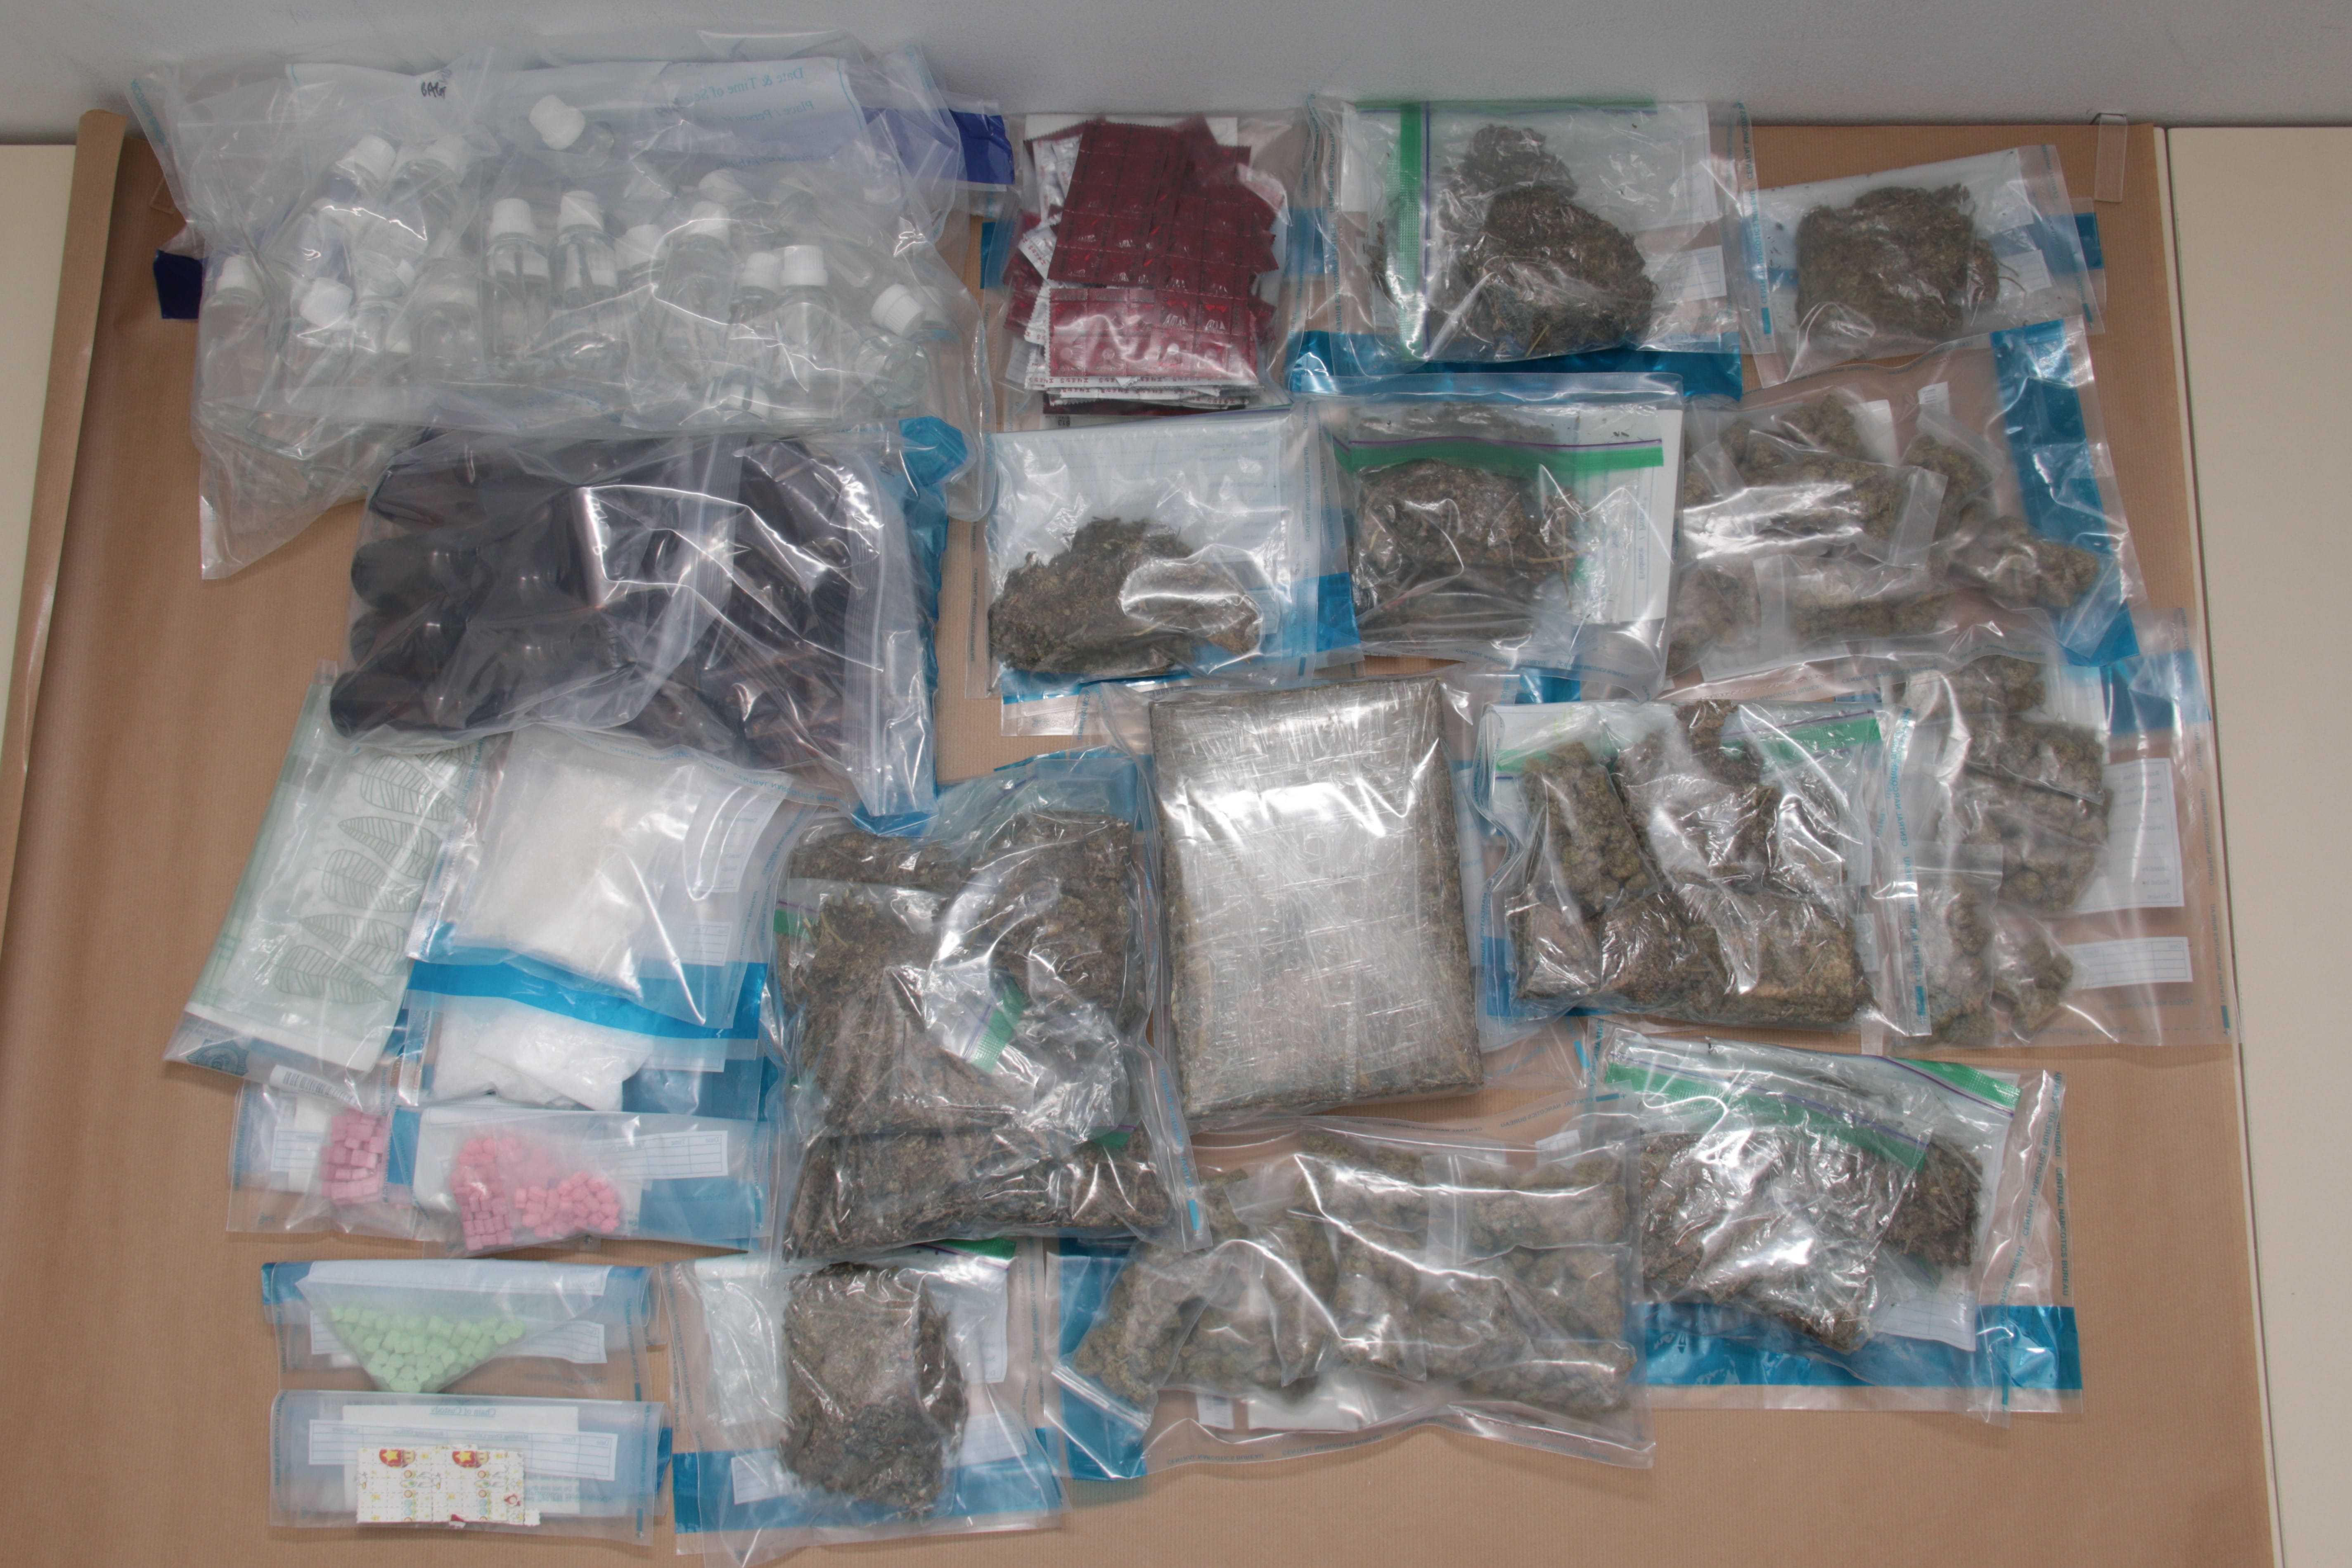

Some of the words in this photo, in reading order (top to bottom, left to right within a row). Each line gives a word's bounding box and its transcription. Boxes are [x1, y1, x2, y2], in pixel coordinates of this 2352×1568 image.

[2055, 1167, 2065, 1206] CENTRAL
[2058, 1208, 2068, 1258] NARCOTICS
[2061, 1260, 2070, 1296] BUREAU
